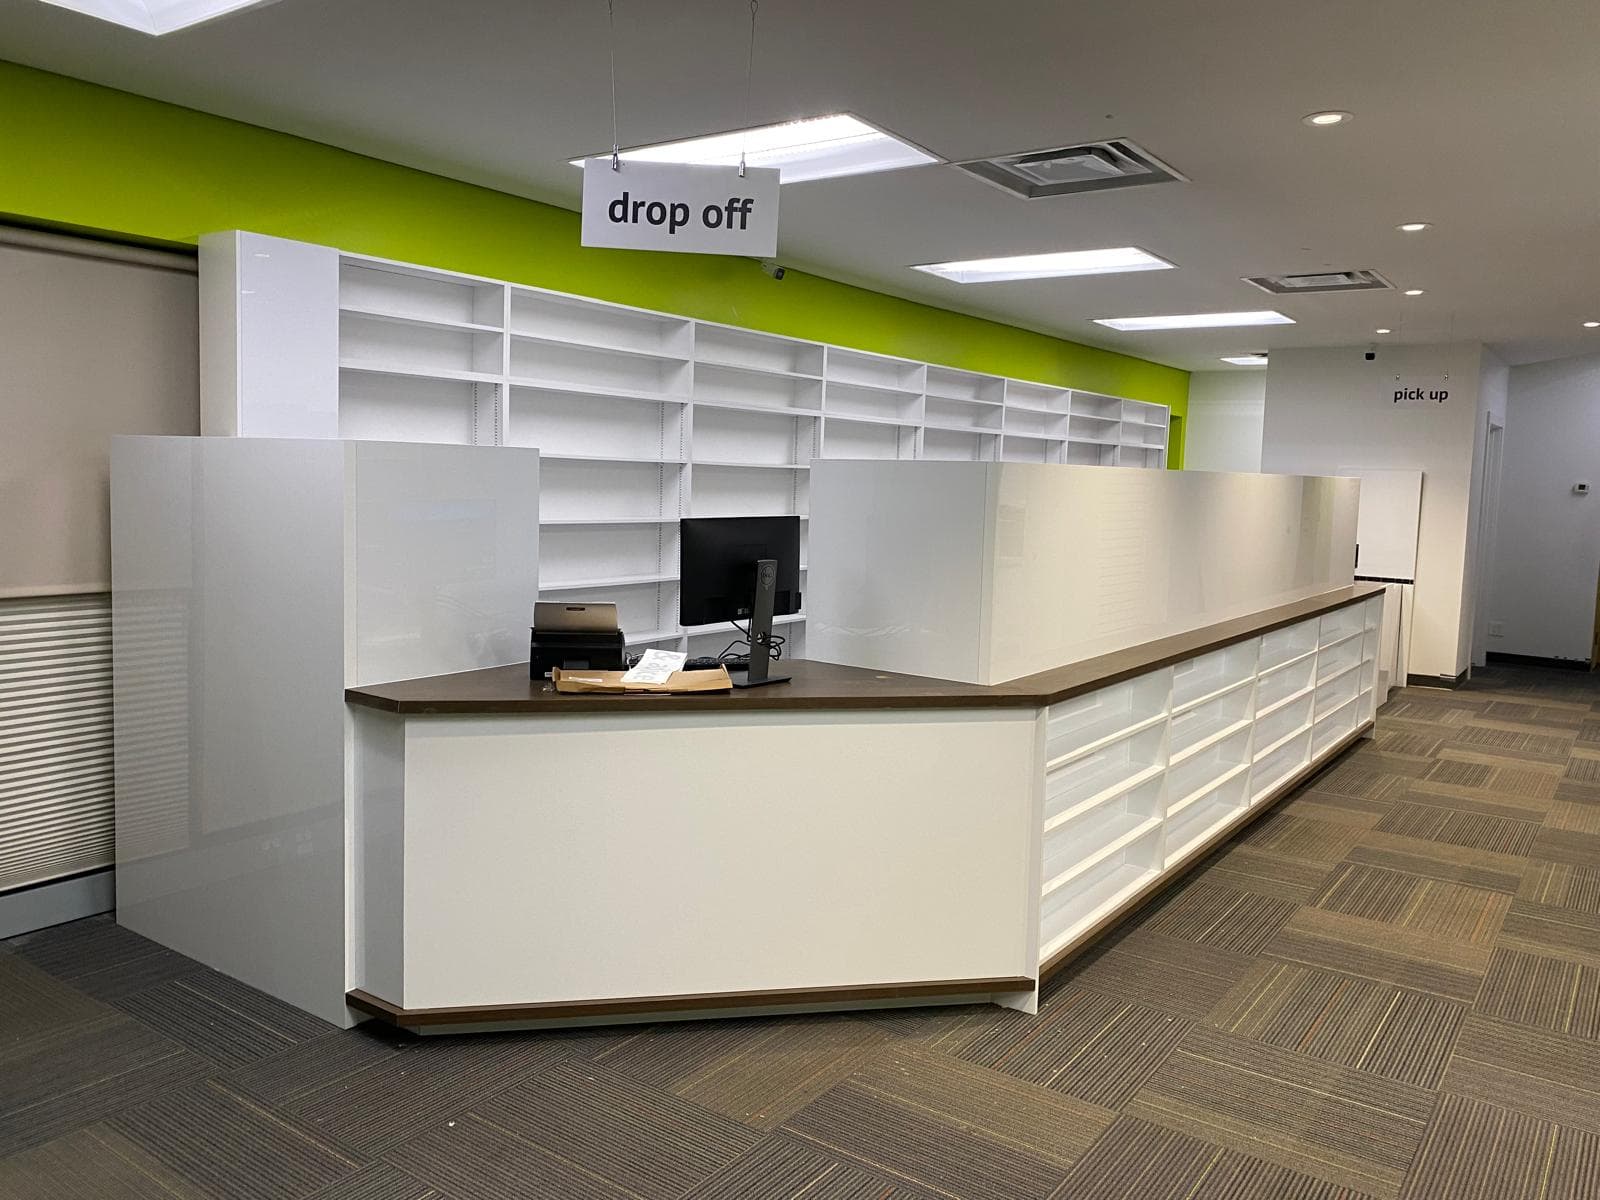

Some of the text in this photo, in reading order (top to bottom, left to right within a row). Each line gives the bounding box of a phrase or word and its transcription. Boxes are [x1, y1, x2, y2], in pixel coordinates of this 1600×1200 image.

[608, 191, 754, 235] drop off
[1393, 387, 1449, 403] pick up
